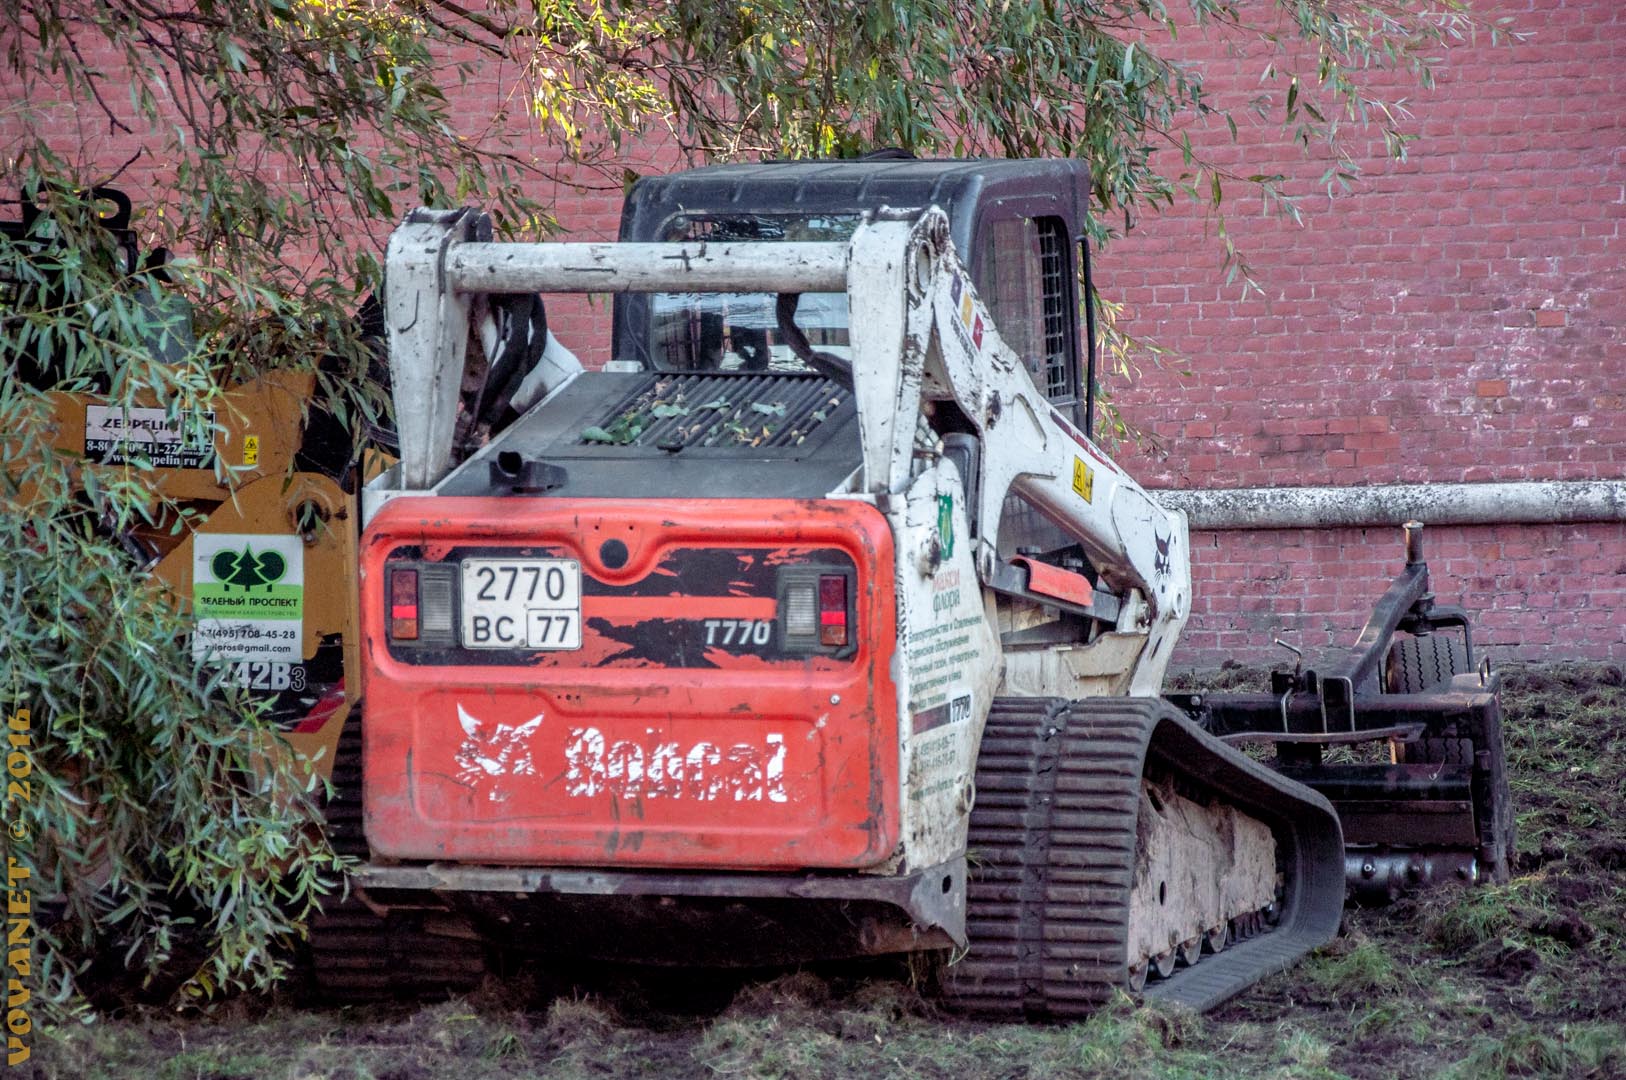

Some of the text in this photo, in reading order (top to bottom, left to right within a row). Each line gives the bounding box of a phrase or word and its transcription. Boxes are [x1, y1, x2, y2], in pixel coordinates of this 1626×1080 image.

[476, 566, 566, 601] 2770
[200, 595, 298, 608] ЗЕЛЕНЫЙ ПРОСПЕКТ
[241, 629, 296, 640] 708-45-28
[536, 615, 571, 643] 77
[704, 619, 772, 645] T770
[204, 644, 291, 654] zlpros@gmail.com
